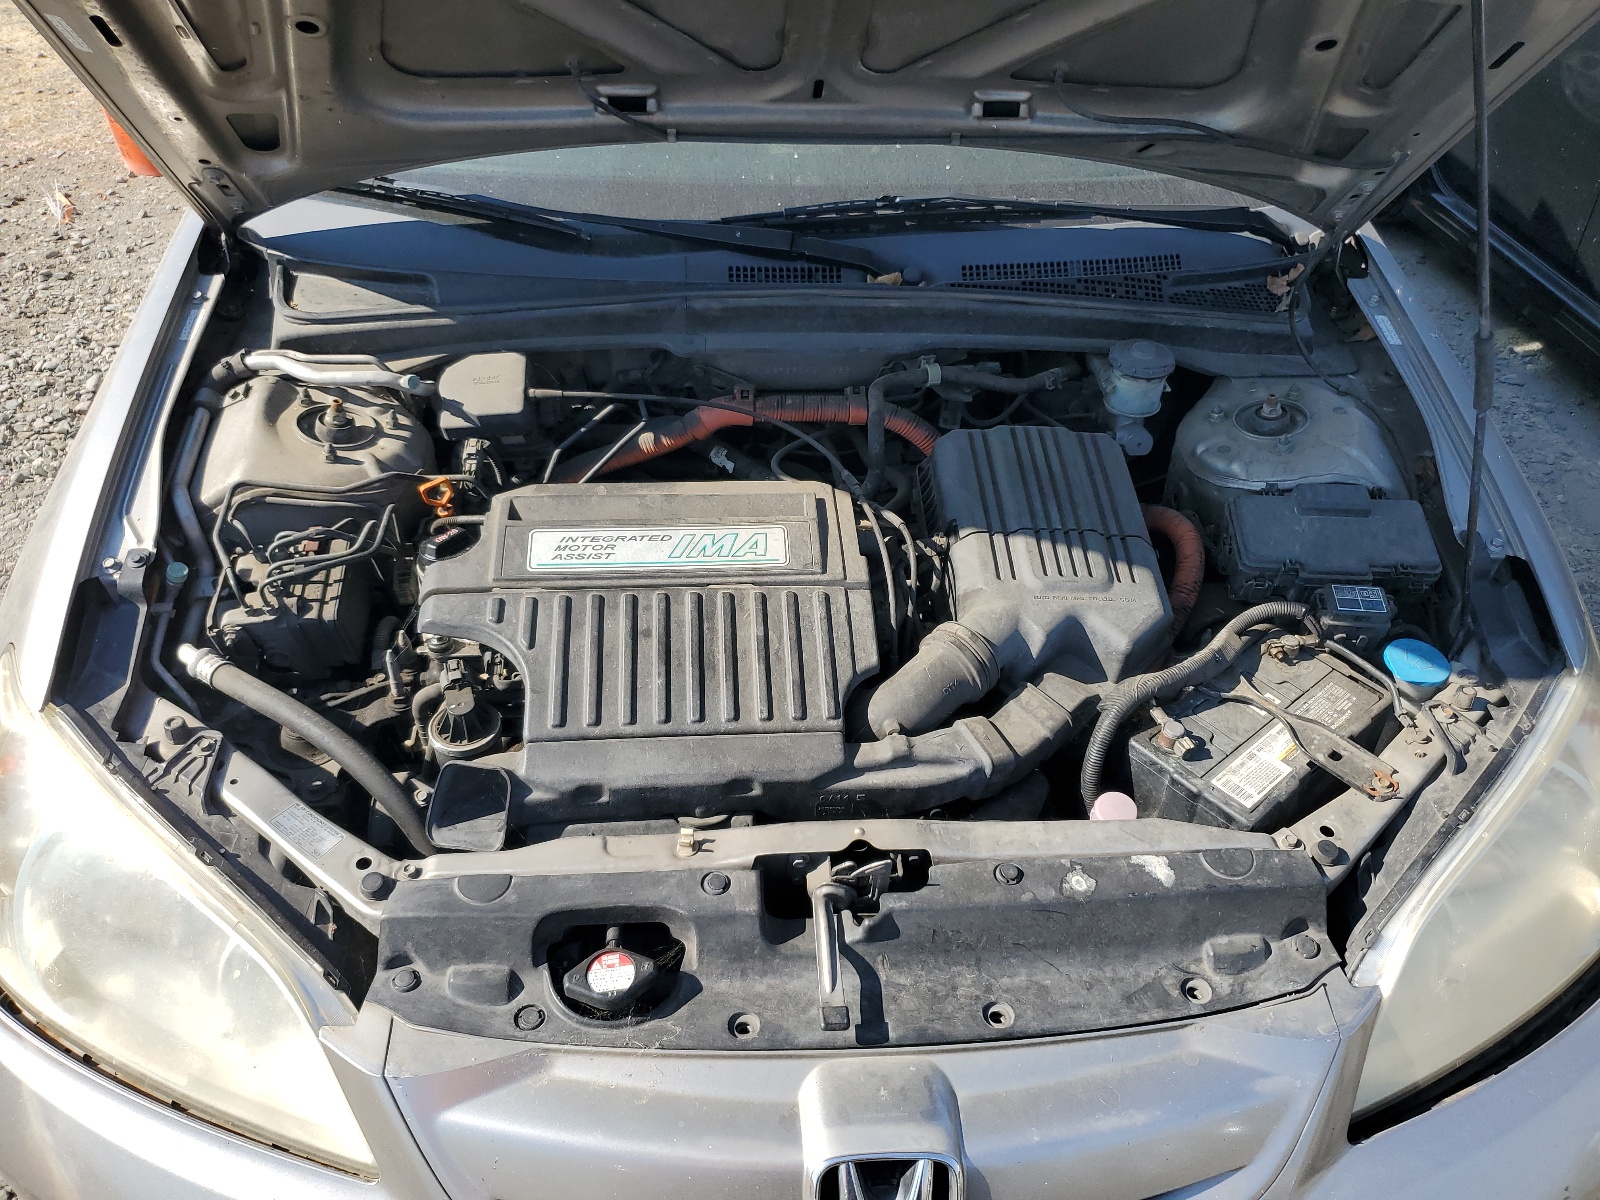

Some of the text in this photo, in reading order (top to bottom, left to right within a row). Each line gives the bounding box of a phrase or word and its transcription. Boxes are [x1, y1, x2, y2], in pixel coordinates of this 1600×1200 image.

[559, 534, 673, 544] INTEGRATED
[554, 544, 617, 552] MOTOR
[668, 532, 768, 559] IMA
[551, 552, 616, 561] ASSIST
